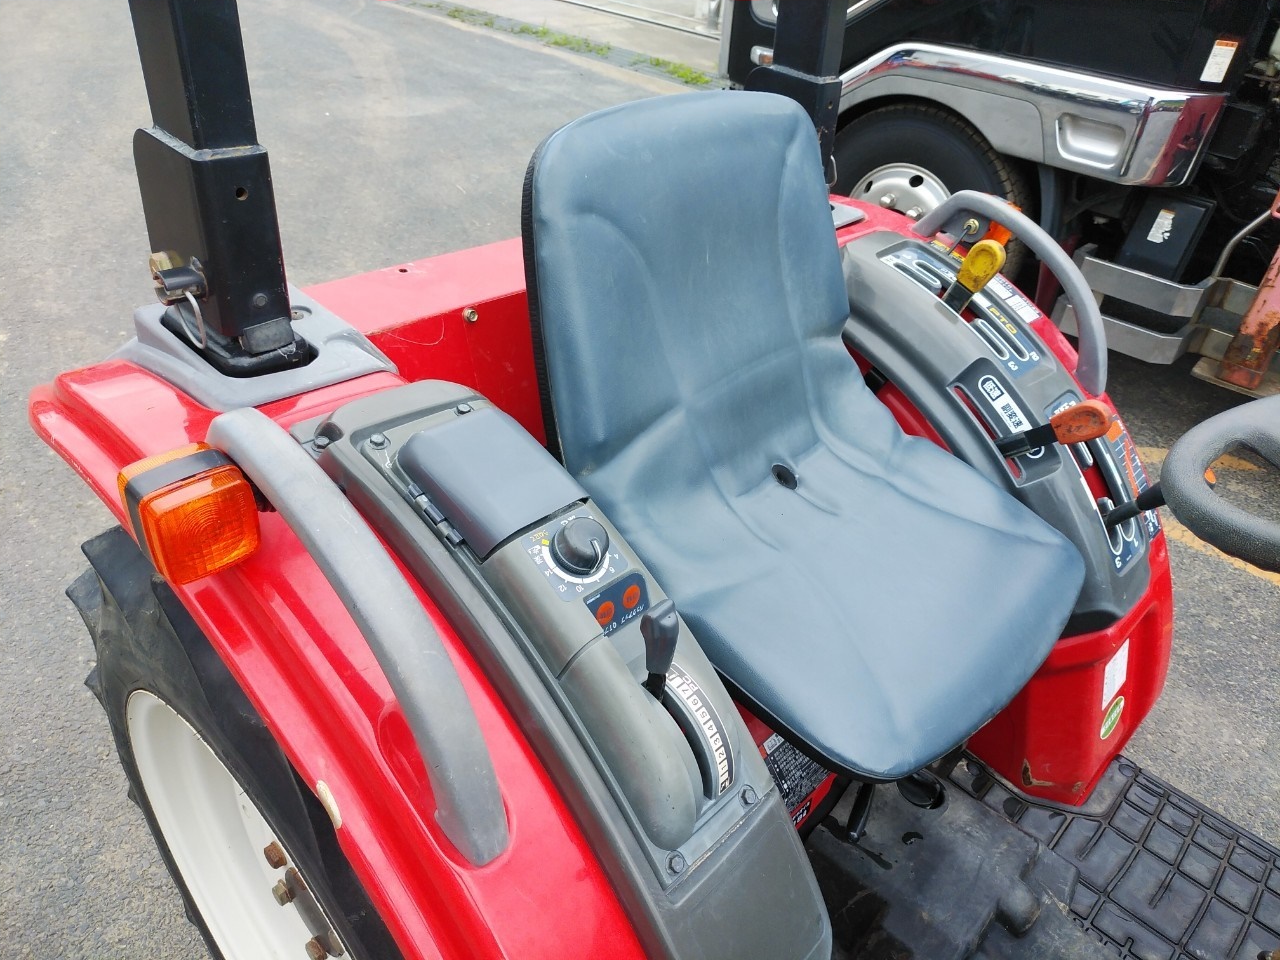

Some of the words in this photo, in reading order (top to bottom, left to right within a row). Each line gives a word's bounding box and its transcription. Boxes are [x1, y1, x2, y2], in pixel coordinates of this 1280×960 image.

[989, 307, 1017, 334] PTO
[1029, 351, 1039, 361] 2
[1008, 361, 1018, 371] 3
[1000, 402, 1023, 429] 副変速
[1115, 556, 1121, 568] 3
[543, 567, 553, 576] 14
[557, 582, 567, 592] 12
[574, 583, 584, 593] 10
